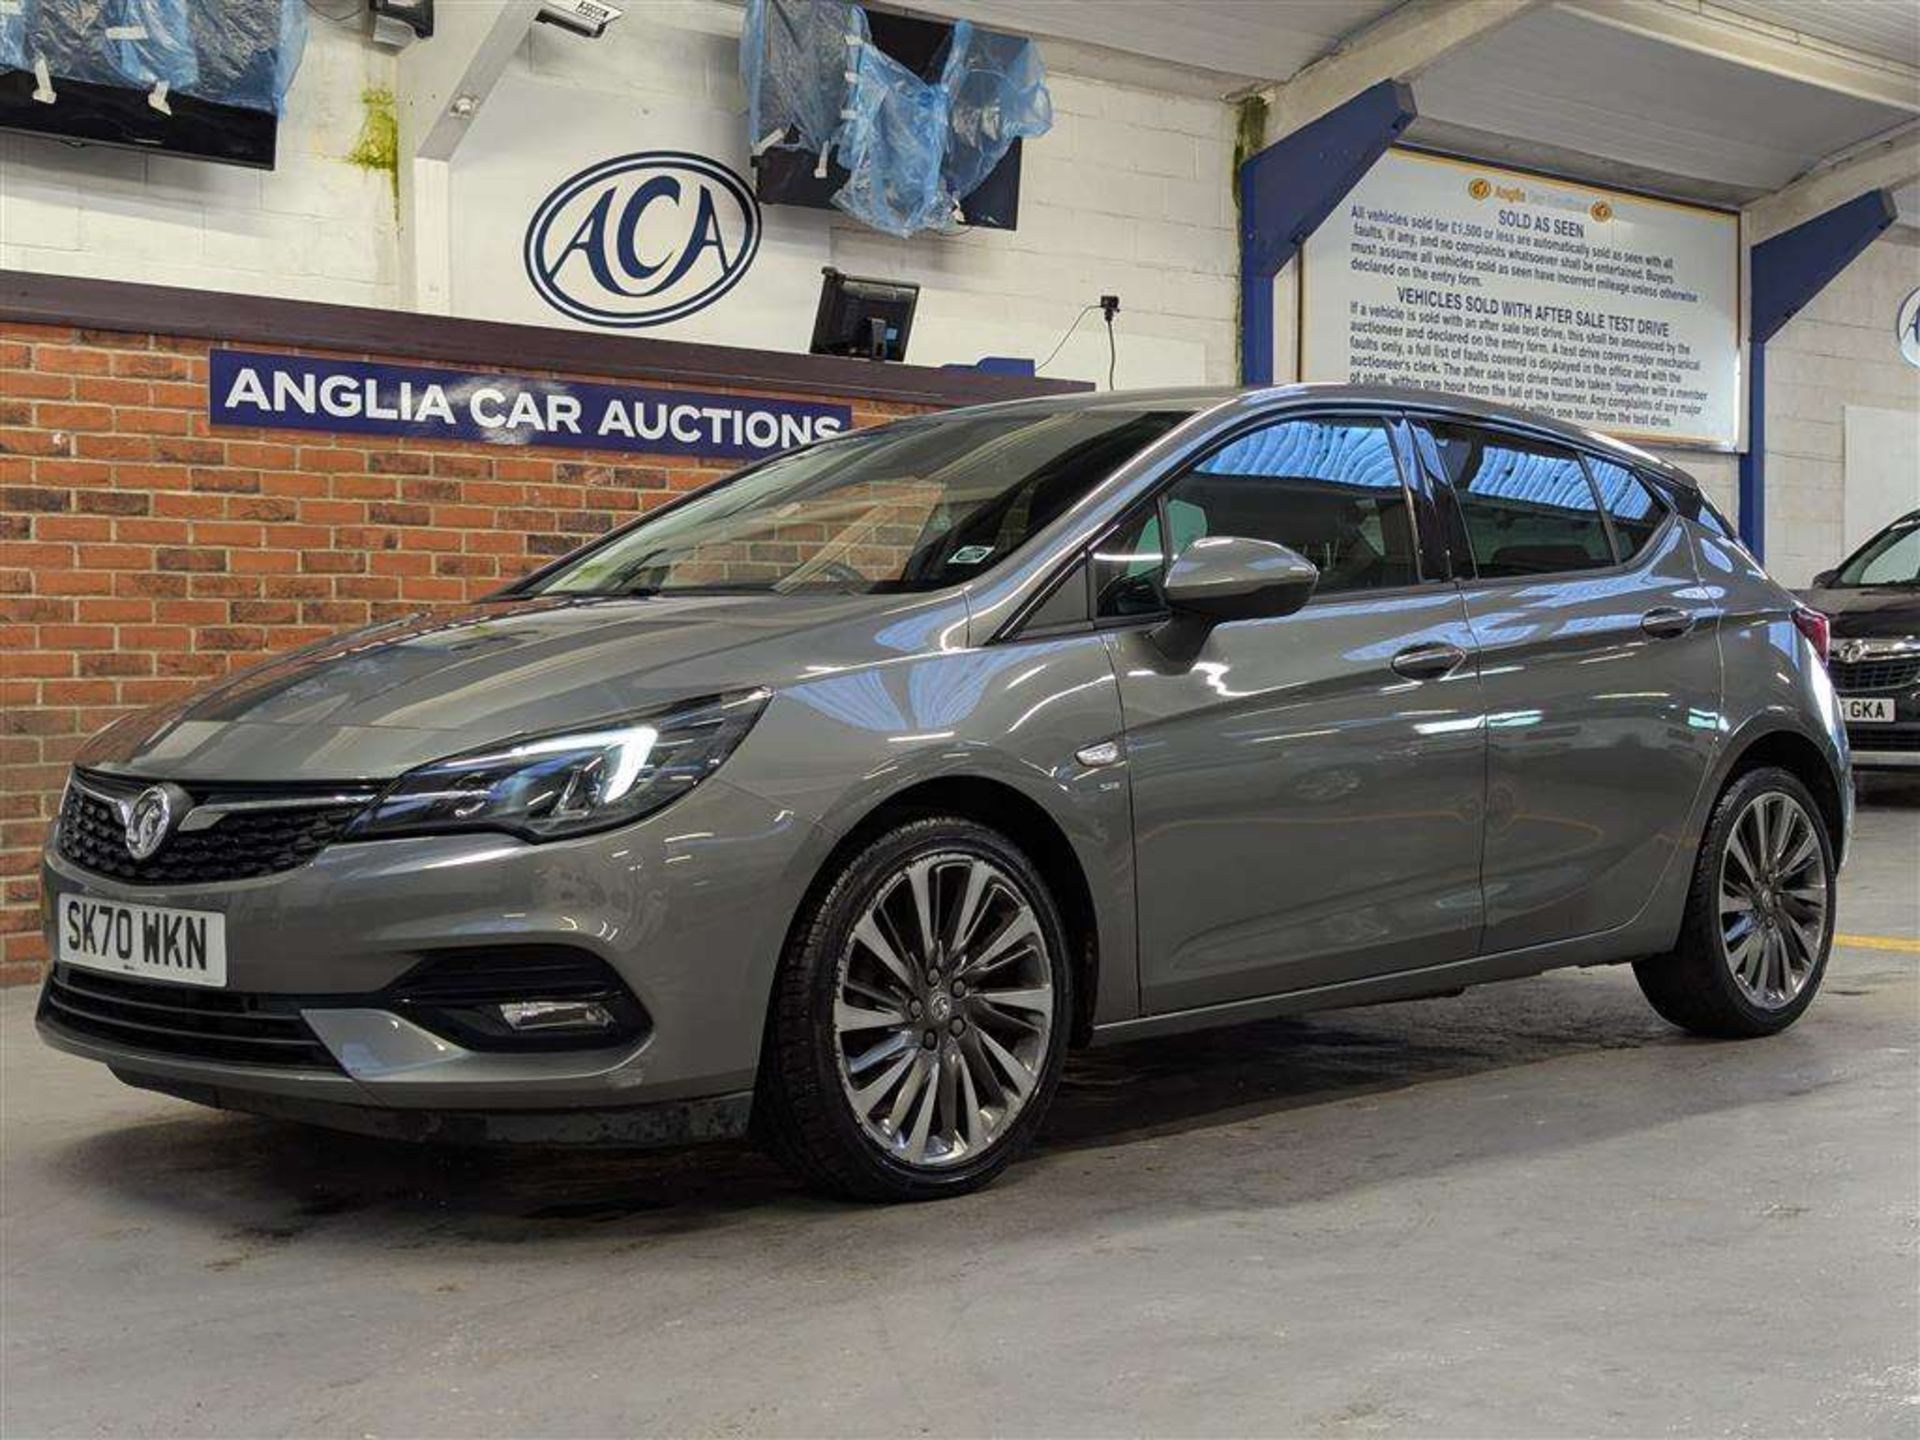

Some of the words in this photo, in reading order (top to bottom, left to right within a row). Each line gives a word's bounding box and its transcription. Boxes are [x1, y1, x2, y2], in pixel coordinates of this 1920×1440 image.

[547, 175, 730, 297] ACA
[1351, 206, 1364, 218] All
[1367, 210, 1408, 226] vehicles
[1412, 216, 1432, 230] sold
[1436, 219, 1448, 232] for
[1484, 229, 1493, 239] or
[1496, 229, 1515, 242] less
[1517, 234, 1531, 246] are
[1534, 237, 1590, 258] automatically
[1592, 247, 1610, 260] sold
[1613, 251, 1622, 260] as
[1624, 252, 1642, 264] seen
[1646, 255, 1661, 266] with
[1664, 257, 1673, 269] all
[1498, 210, 1530, 229] SOLD
[1534, 216, 1550, 232] AS
[1554, 219, 1584, 238] SEEN
[1350, 258, 1394, 275] declared
[1397, 266, 1410, 276] on
[1412, 267, 1428, 280] the
[1430, 270, 1456, 286] entry
[1352, 242, 1376, 255] must
[1380, 246, 1417, 261] assume
[1421, 252, 1432, 262] all
[1434, 254, 1474, 270] vehicles
[1476, 260, 1496, 273] sold
[1498, 264, 1508, 274] as
[1512, 266, 1532, 278] seen
[1535, 268, 1554, 282] have
[1558, 272, 1596, 288] incorrect
[1598, 277, 1629, 294] mileage
[1632, 283, 1658, 297] unless
[1660, 286, 1698, 302] otherwise
[1420, 235, 1438, 248] and
[1440, 239, 1454, 250] no
[1456, 240, 1505, 258] complaints
[1508, 250, 1558, 266] whatsoever
[1561, 256, 1580, 270] shall
[1583, 260, 1594, 272] be
[1646, 269, 1674, 284] Buyers
[1351, 301, 1358, 313] If
[1360, 304, 1366, 315] a
[1369, 305, 1404, 320] vehicle
[1407, 310, 1416, 320] is
[1418, 312, 1440, 324] sold
[1442, 315, 1462, 326] with
[1465, 318, 1476, 328] an
[1479, 319, 1498, 330] after
[1502, 322, 1520, 333] sale
[1522, 324, 1540, 336] test
[1568, 329, 1584, 342] this
[1586, 332, 1606, 345] shall
[1609, 334, 1618, 346] be
[1622, 336, 1664, 351] announced
[1666, 342, 1676, 354] by
[1678, 343, 1690, 354] the
[1398, 287, 1462, 310] VEHICLES
[1466, 296, 1498, 314] SOLD
[1502, 301, 1532, 318] WITH
[1535, 306, 1572, 324] AFTER
[1576, 310, 1604, 328] SALE
[1608, 315, 1635, 332] TEST
[1638, 319, 1669, 337] DRIVE
[1350, 320, 1403, 336] auctioneer
[1406, 327, 1423, 338] and
[1426, 329, 1468, 344] declared
[1472, 336, 1484, 346] on
[1486, 336, 1498, 347] the
[1502, 340, 1524, 354] entry
[1552, 342, 1558, 354] A
[1560, 345, 1577, 358] test
[1580, 347, 1600, 360] drive
[1602, 350, 1630, 363] covers
[1632, 353, 1654, 368] major
[1656, 354, 1700, 370] mechanical
[1350, 335, 1378, 350] faults
[1408, 345, 1414, 354] a
[1416, 342, 1431, 356] full
[1434, 346, 1449, 358] list
[1451, 348, 1461, 359] of
[1464, 349, 1488, 362] faults
[1491, 354, 1526, 368] covered
[1530, 356, 1537, 368] is
[1540, 356, 1581, 375] displayed
[1583, 361, 1592, 373] in
[1594, 362, 1607, 375] the
[1609, 364, 1632, 379] office
[1634, 368, 1649, 380] and
[1652, 370, 1666, 382] with
[1669, 372, 1681, 384] the
[1350, 354, 1410, 371] auctioneer's
[1414, 360, 1440, 374] clerk.
[1444, 363, 1460, 376] The
[1463, 365, 1484, 378] after
[1486, 368, 1506, 380] sale
[1508, 370, 1525, 382] test
[1526, 372, 1548, 384] drive
[1550, 374, 1572, 388] must
[1575, 378, 1586, 388] be
[1615, 382, 1649, 396] together
[1652, 384, 1668, 396] with
[1670, 388, 1674, 397] a
[1676, 388, 1708, 400] member
[1350, 372, 1360, 384] of
[1424, 380, 1441, 390] one
[1444, 380, 1466, 393] hour
[1468, 381, 1490, 394] from
[1492, 384, 1506, 396] the
[1508, 386, 1522, 398] fall
[1524, 388, 1534, 399] of
[1536, 389, 1550, 400] the
[1590, 394, 1606, 407] Any
[1608, 396, 1652, 411] complaints
[1654, 400, 1662, 410] of
[1664, 402, 1678, 415] any
[1680, 402, 1702, 416] major
[224, 368, 456, 425] ANGLIA
[469, 388, 583, 434] CAR
[598, 399, 841, 449] AUCTIONS
[1556, 408, 1573, 418] one
[1575, 408, 1595, 420] hour
[1597, 410, 1616, 422] from
[1618, 412, 1631, 423] the
[1633, 413, 1648, 424] test
[1850, 701, 1885, 719] GKA
[68, 901, 132, 960] SK70
[142, 911, 207, 970] WKN
